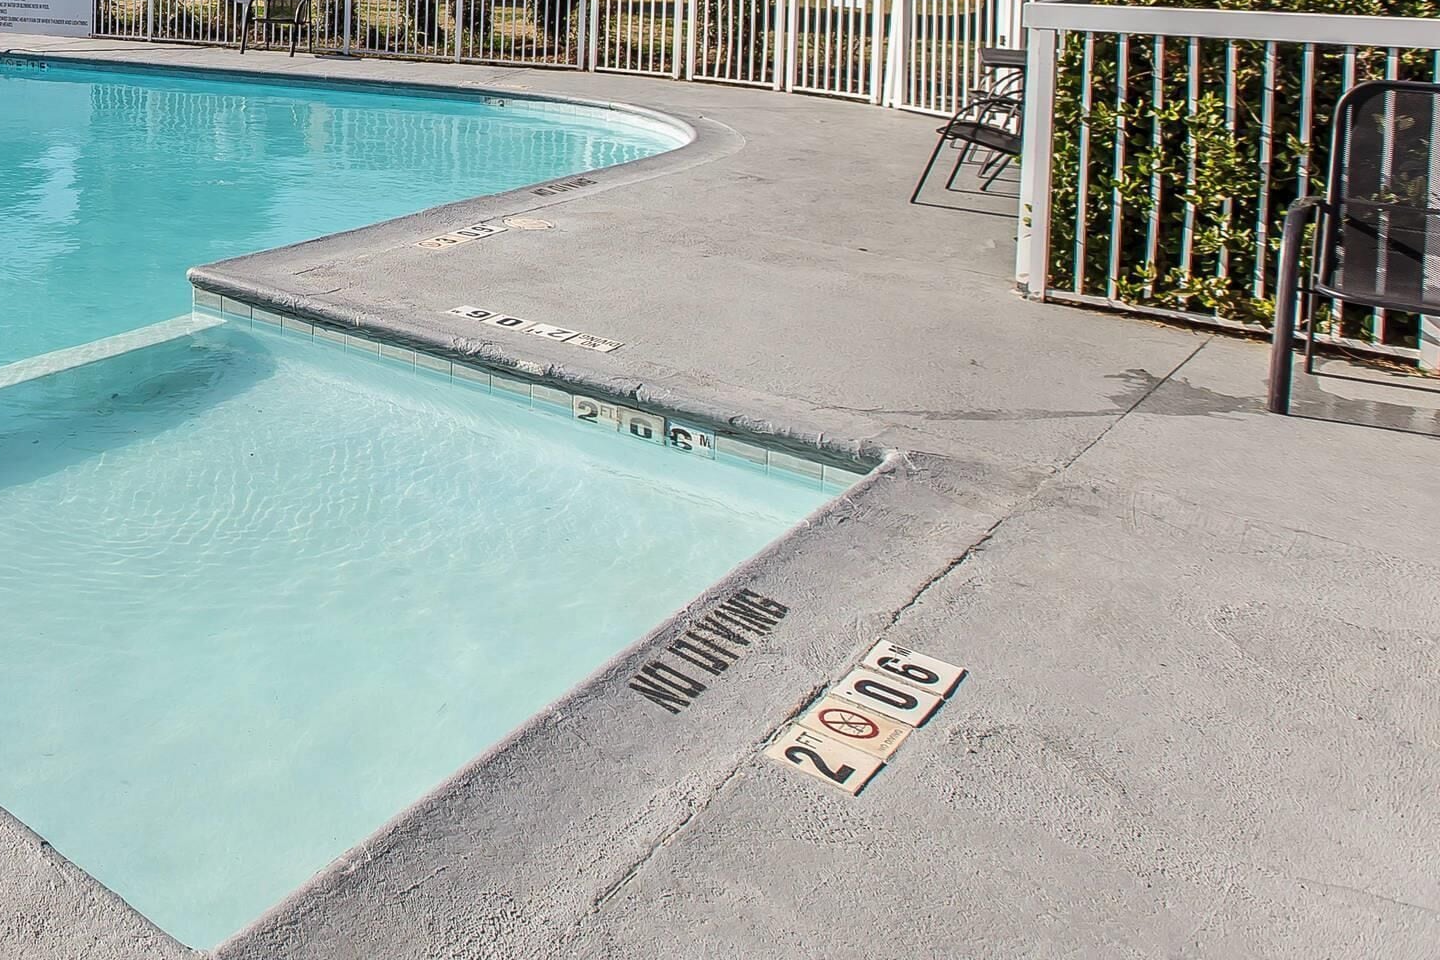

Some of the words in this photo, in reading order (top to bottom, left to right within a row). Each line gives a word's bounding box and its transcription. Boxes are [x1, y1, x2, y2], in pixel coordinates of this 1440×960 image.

[578, 400, 599, 424] 2
[668, 588, 791, 677] DIVING
[888, 644, 914, 658] M
[629, 660, 708, 715] NO
[796, 730, 824, 750] FT
[784, 745, 856, 785] 2
